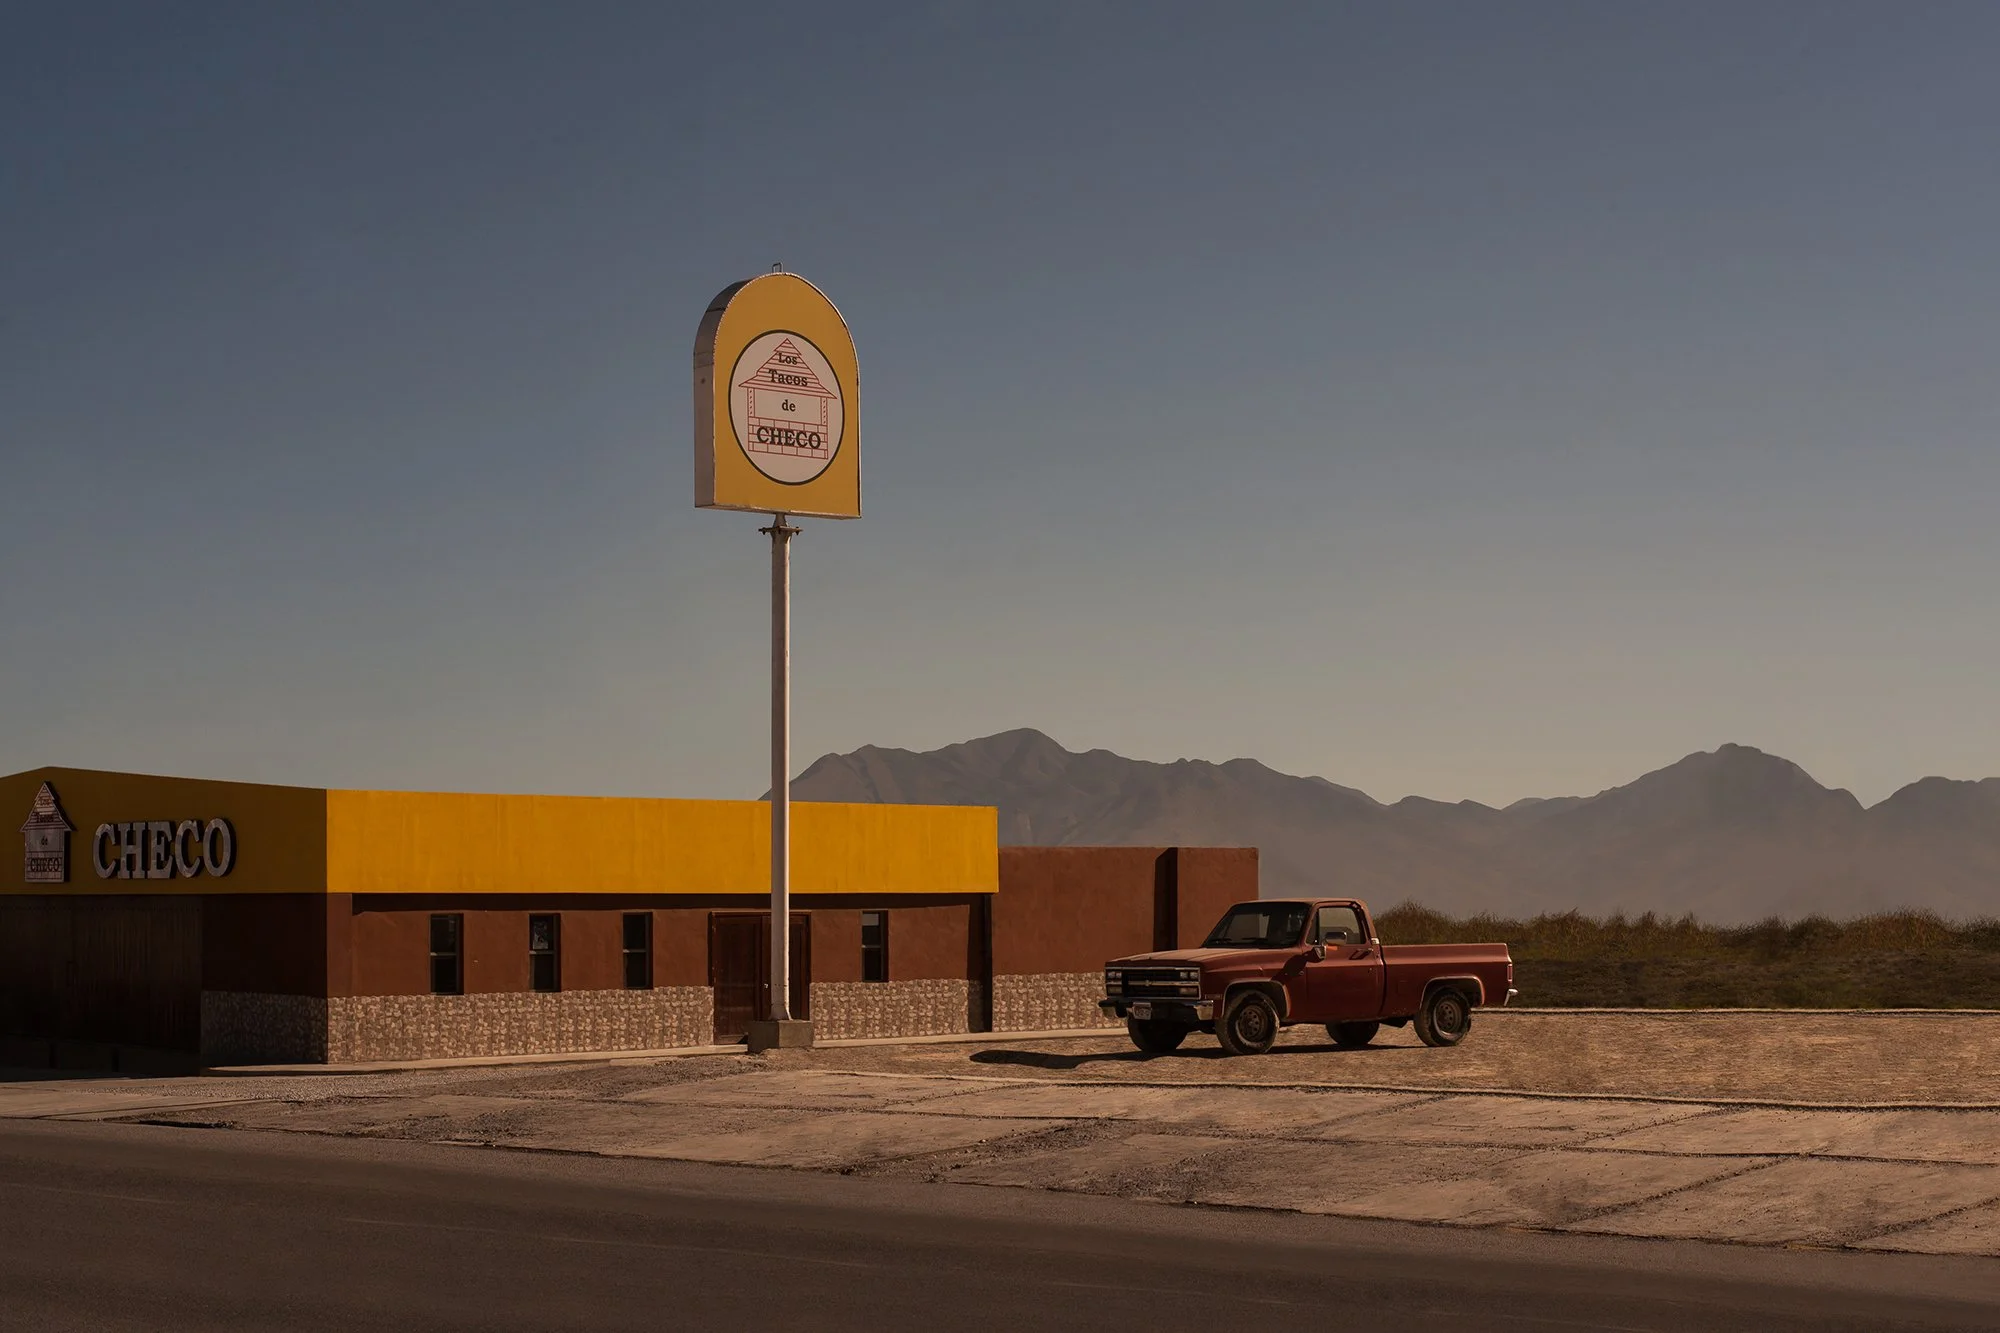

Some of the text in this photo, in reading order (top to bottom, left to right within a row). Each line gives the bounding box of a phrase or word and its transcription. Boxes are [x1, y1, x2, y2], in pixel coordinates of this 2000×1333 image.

[778, 352, 798, 365] Los
[768, 368, 808, 386] Tacos
[781, 399, 796, 412] de
[756, 426, 821, 449] CHECO
[93, 818, 232, 879] CHECO
[30, 857, 60, 872] CHECO
